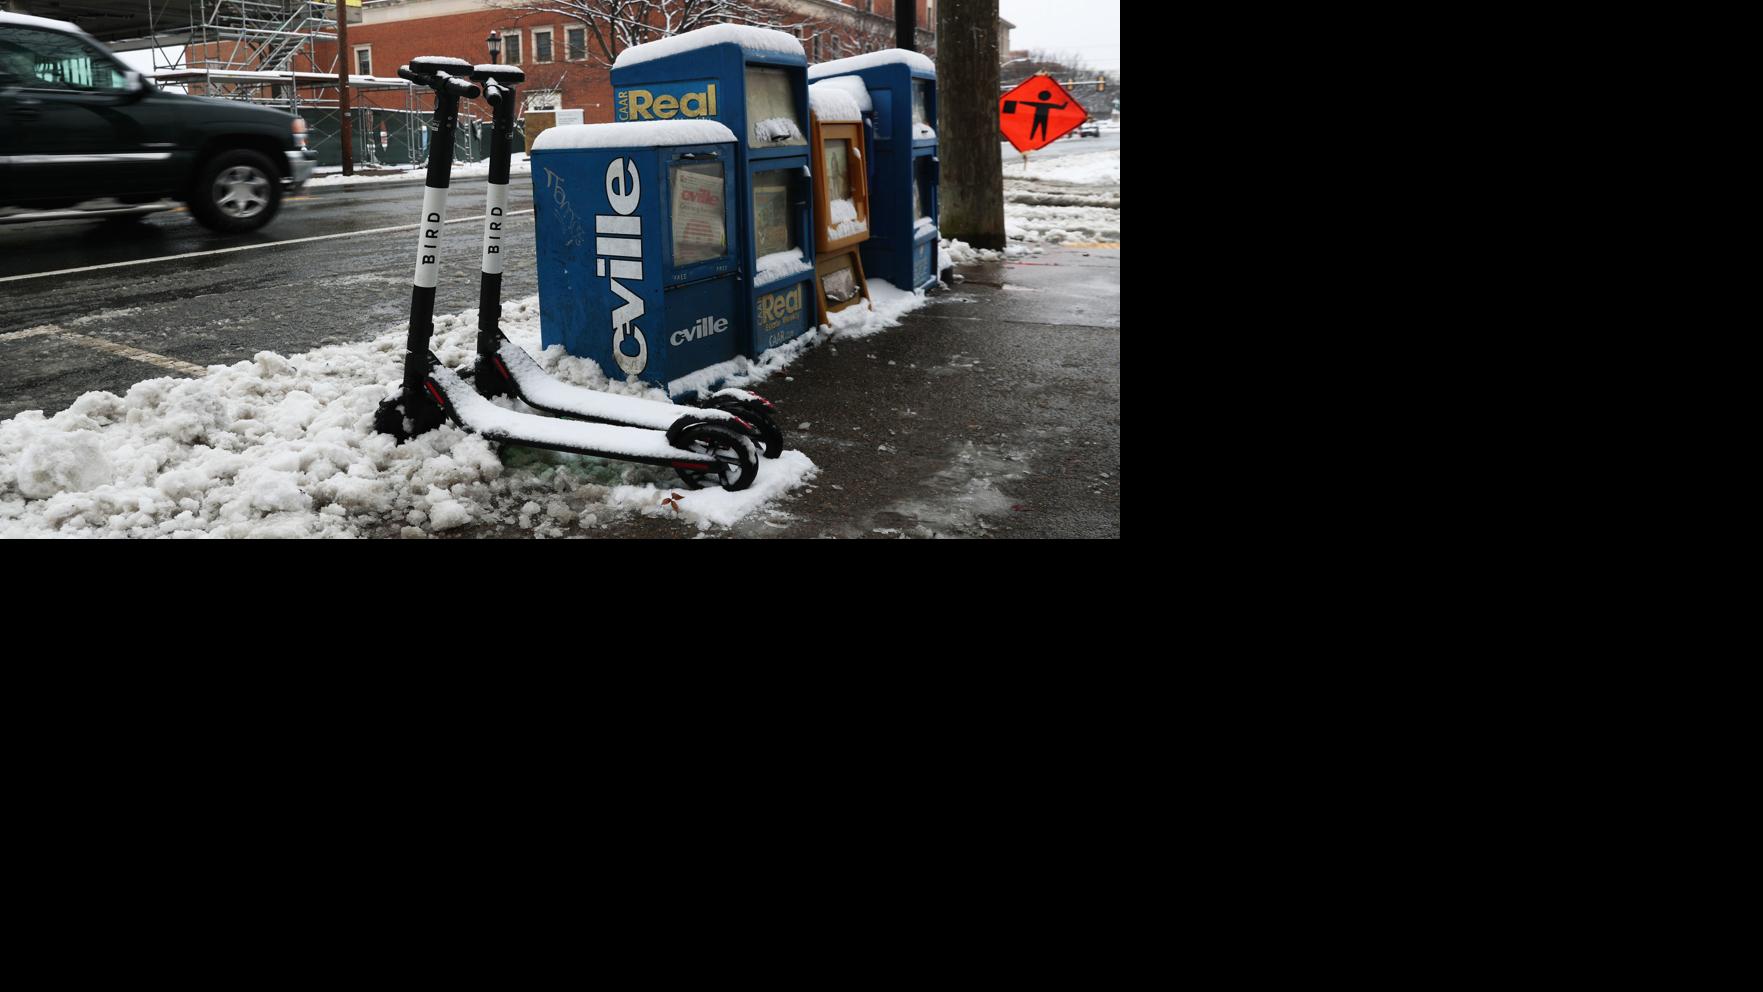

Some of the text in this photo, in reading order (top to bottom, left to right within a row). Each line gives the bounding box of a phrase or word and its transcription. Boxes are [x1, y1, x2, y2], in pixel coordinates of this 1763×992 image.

[618, 91, 628, 120] CAAR
[628, 84, 717, 120] Real
[422, 212, 440, 265] BIRD
[488, 206, 502, 254] BIRD
[762, 283, 802, 325] Real
